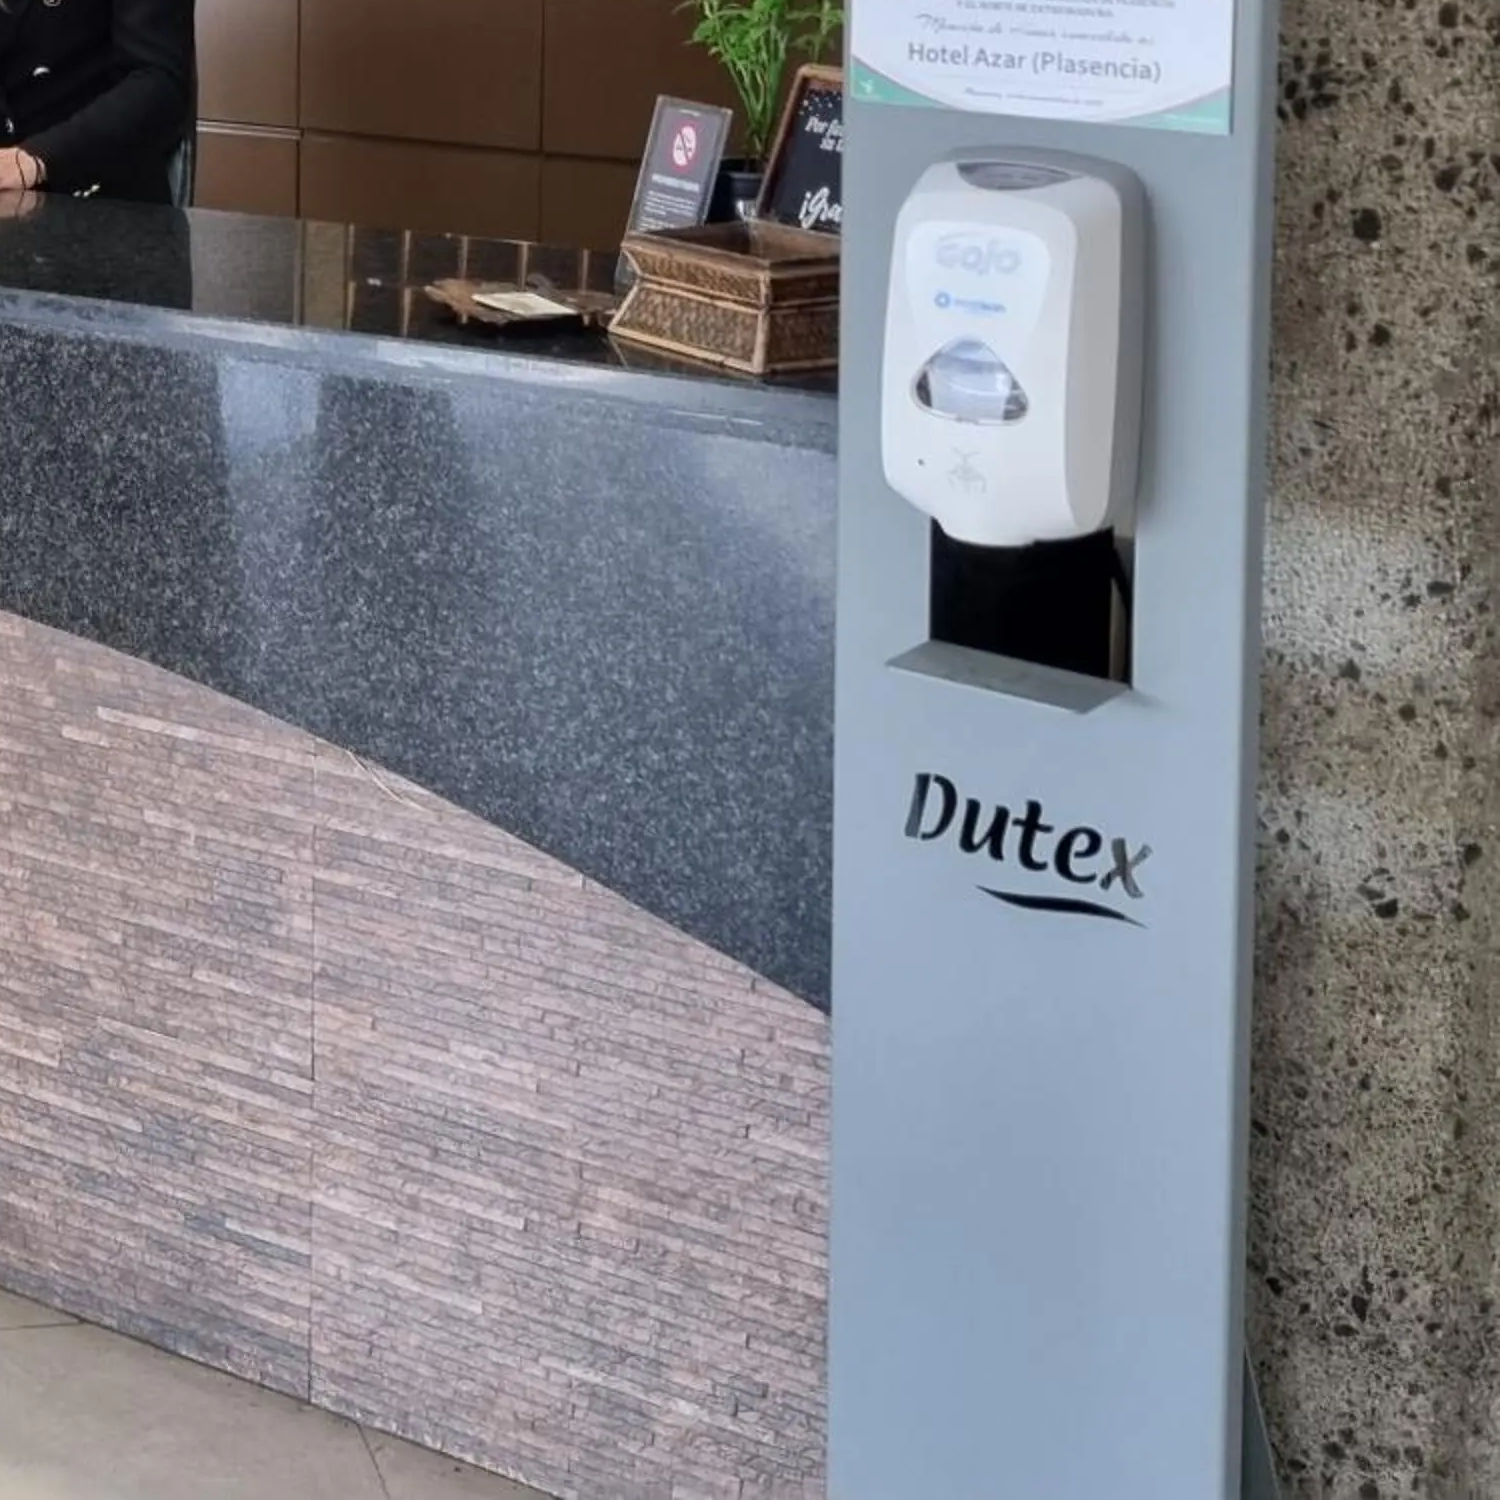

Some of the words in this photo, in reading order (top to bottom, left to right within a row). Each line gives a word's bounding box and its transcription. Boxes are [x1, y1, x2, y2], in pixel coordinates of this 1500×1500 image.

[907, 42, 969, 66] Hotel
[974, 47, 1027, 70] Azar
[1032, 50, 1162, 85] (Plasencia)
[904, 772, 1153, 899] Dutex
